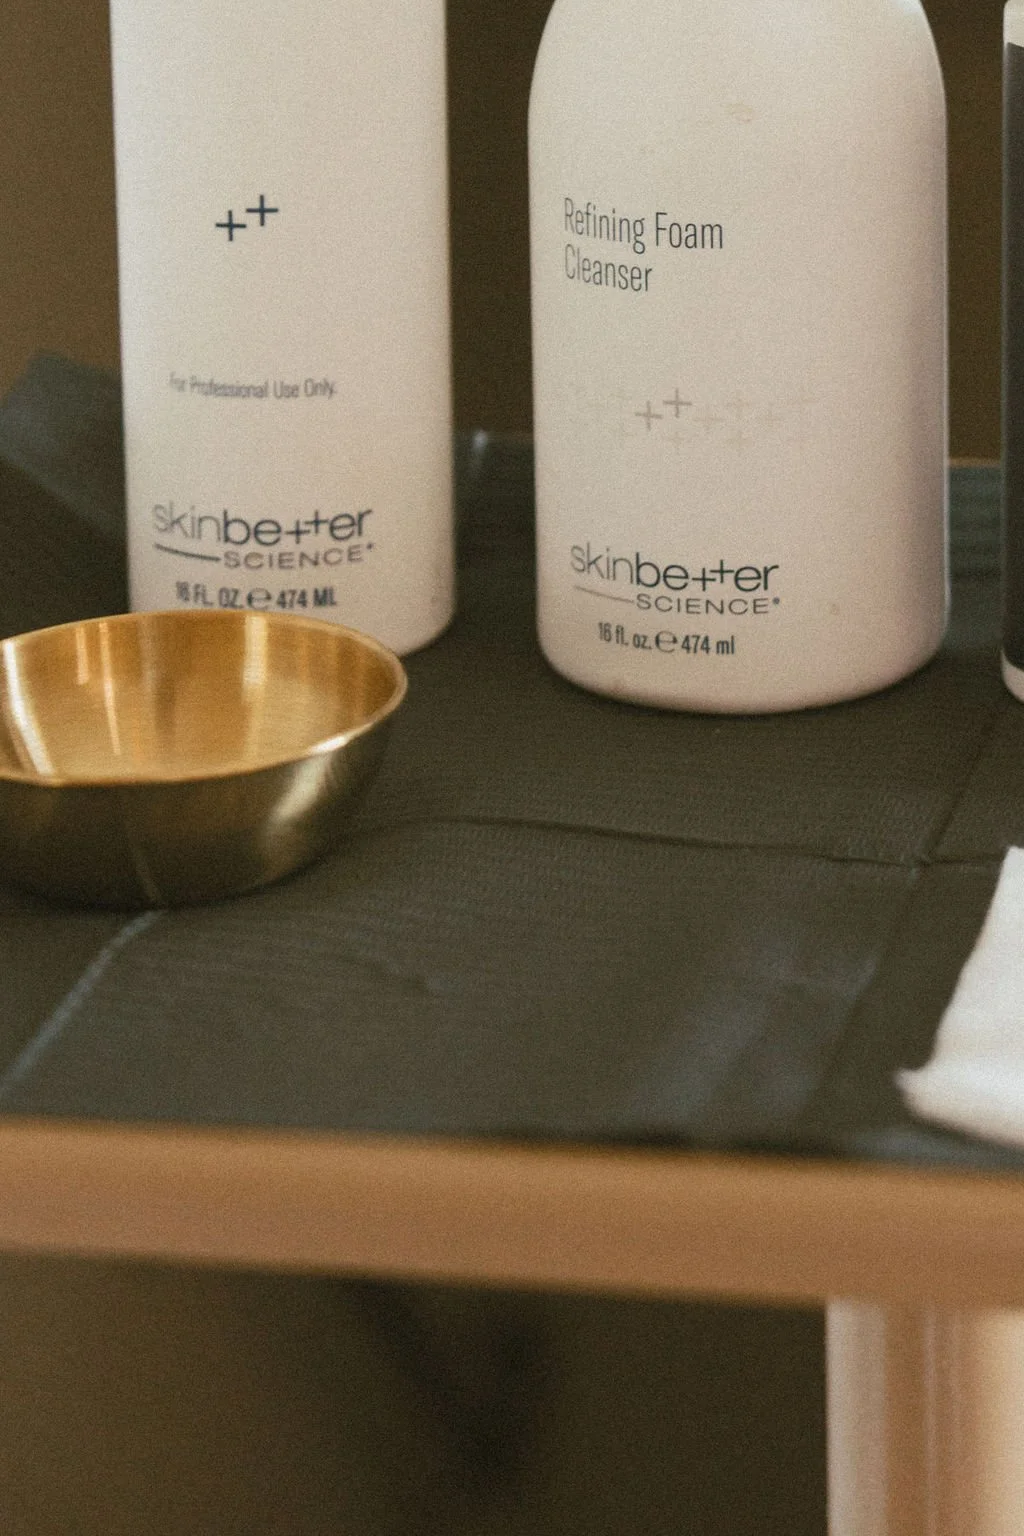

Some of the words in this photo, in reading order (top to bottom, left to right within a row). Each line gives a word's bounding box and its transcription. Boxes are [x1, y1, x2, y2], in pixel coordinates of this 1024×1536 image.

[564, 197, 645, 254] Refining
[655, 212, 723, 249] Foam
[565, 244, 652, 291] Cleanser
[273, 380, 300, 399] Use
[276, 589, 308, 609] 474
[313, 586, 337, 608] ML
[598, 622, 612, 642] 16
[633, 633, 652, 650] oz.
[681, 635, 710, 654] 474
[716, 635, 735, 654] ml
